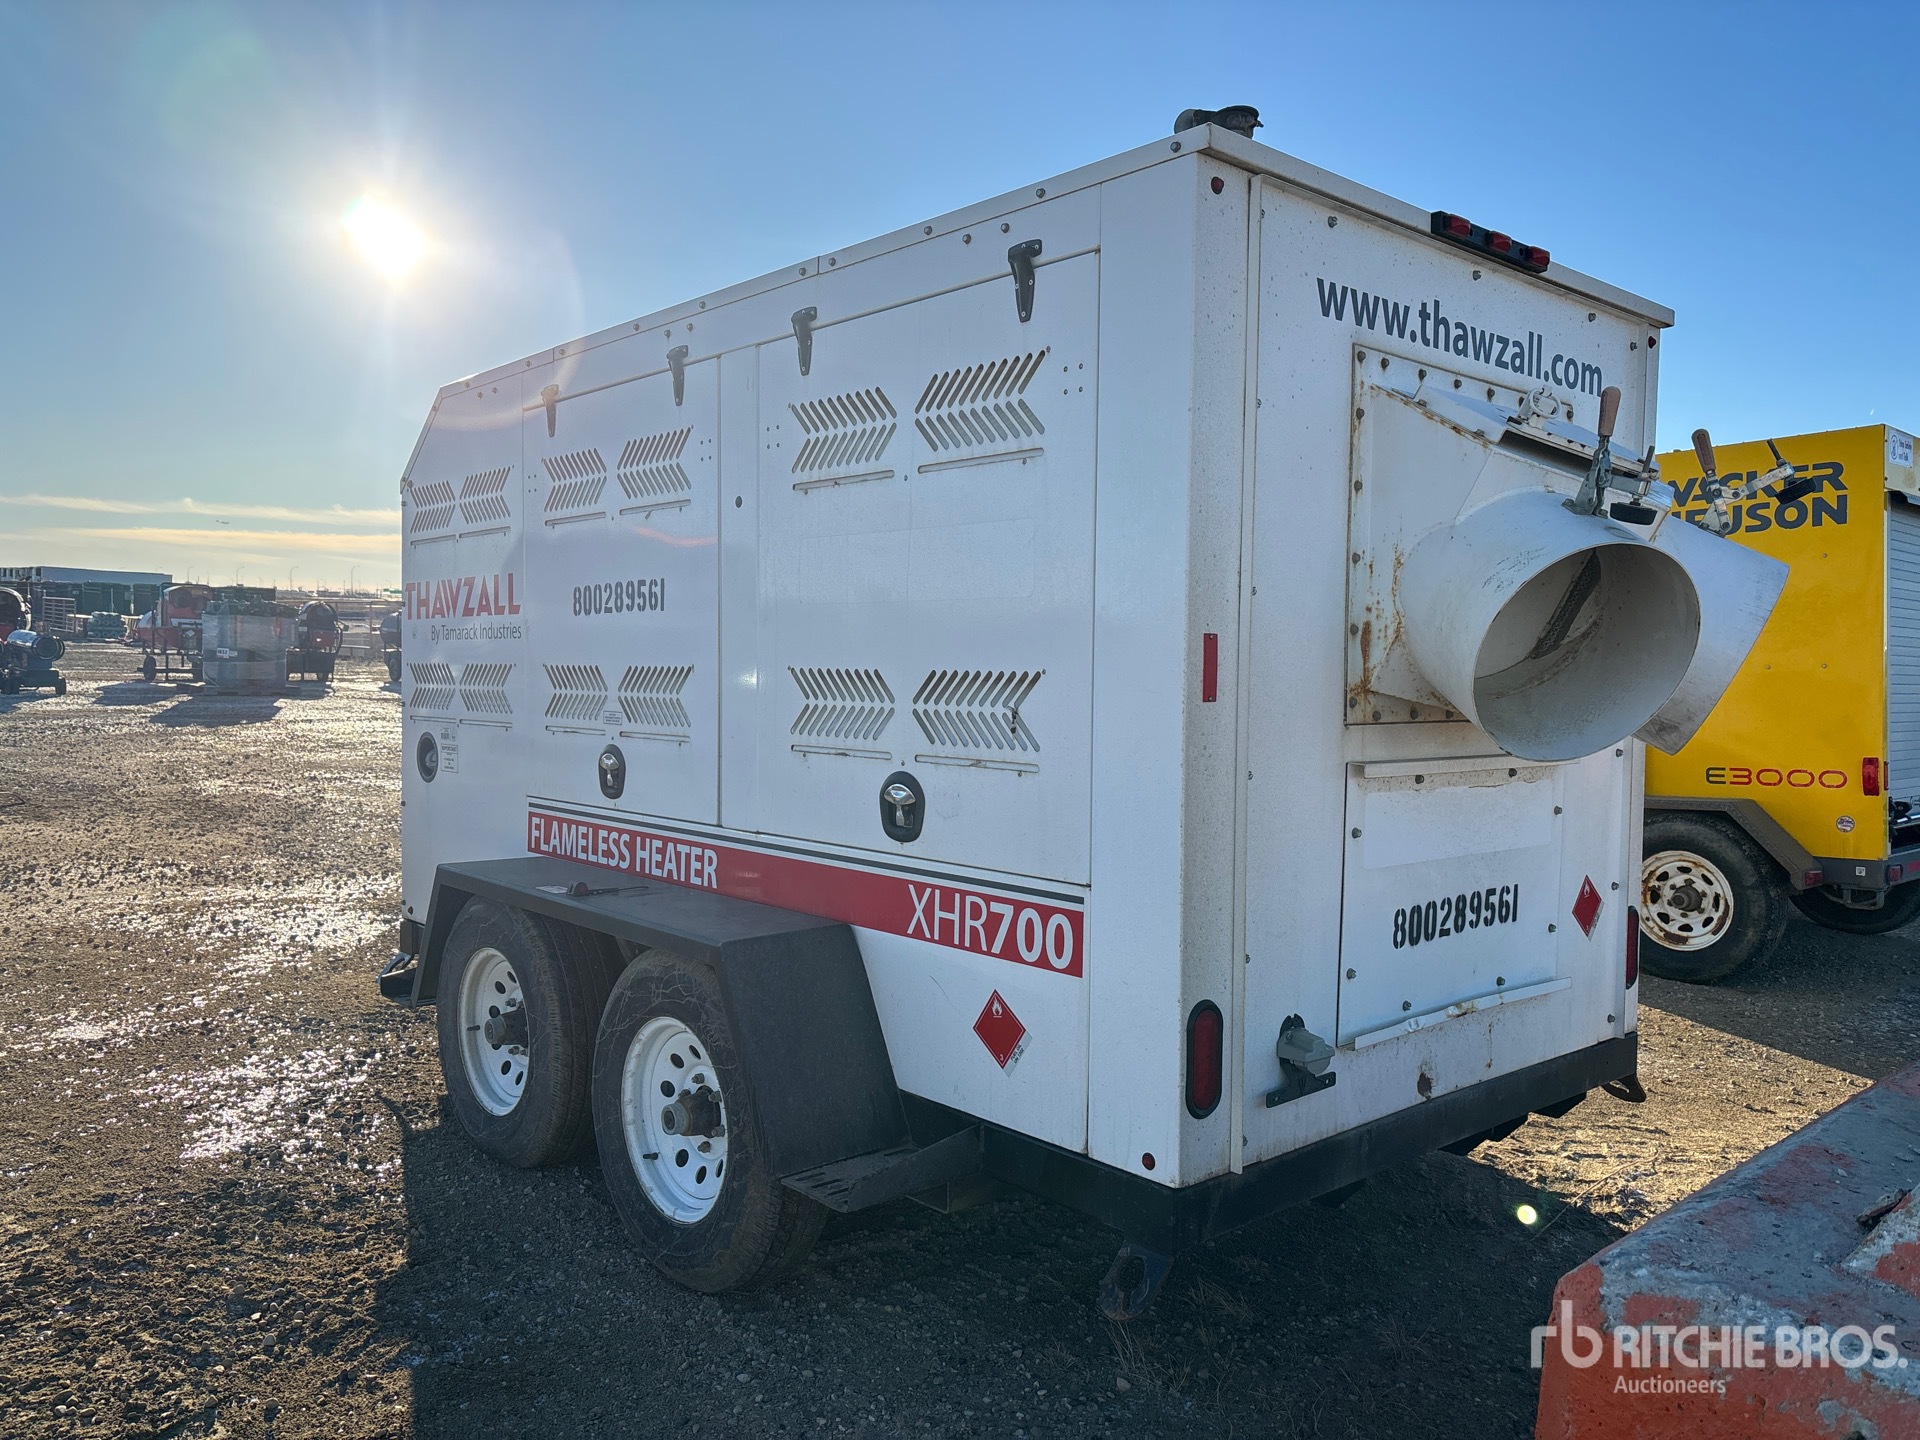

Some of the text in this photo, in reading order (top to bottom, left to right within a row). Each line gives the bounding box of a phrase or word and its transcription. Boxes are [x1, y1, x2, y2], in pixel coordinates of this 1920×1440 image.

[1316, 277, 1603, 398] www.thawzall.com
[405, 573, 521, 620] THAWZALL
[573, 578, 665, 616] 800289561
[431, 622, 522, 645] By Tamarack Industries
[1705, 767, 1848, 789] E3000
[531, 816, 718, 889] FLAMELESS HEATER
[906, 884, 1074, 970] XHR700
[1393, 883, 1519, 950] 800289561
[999, 1053, 1004, 1061] 3
